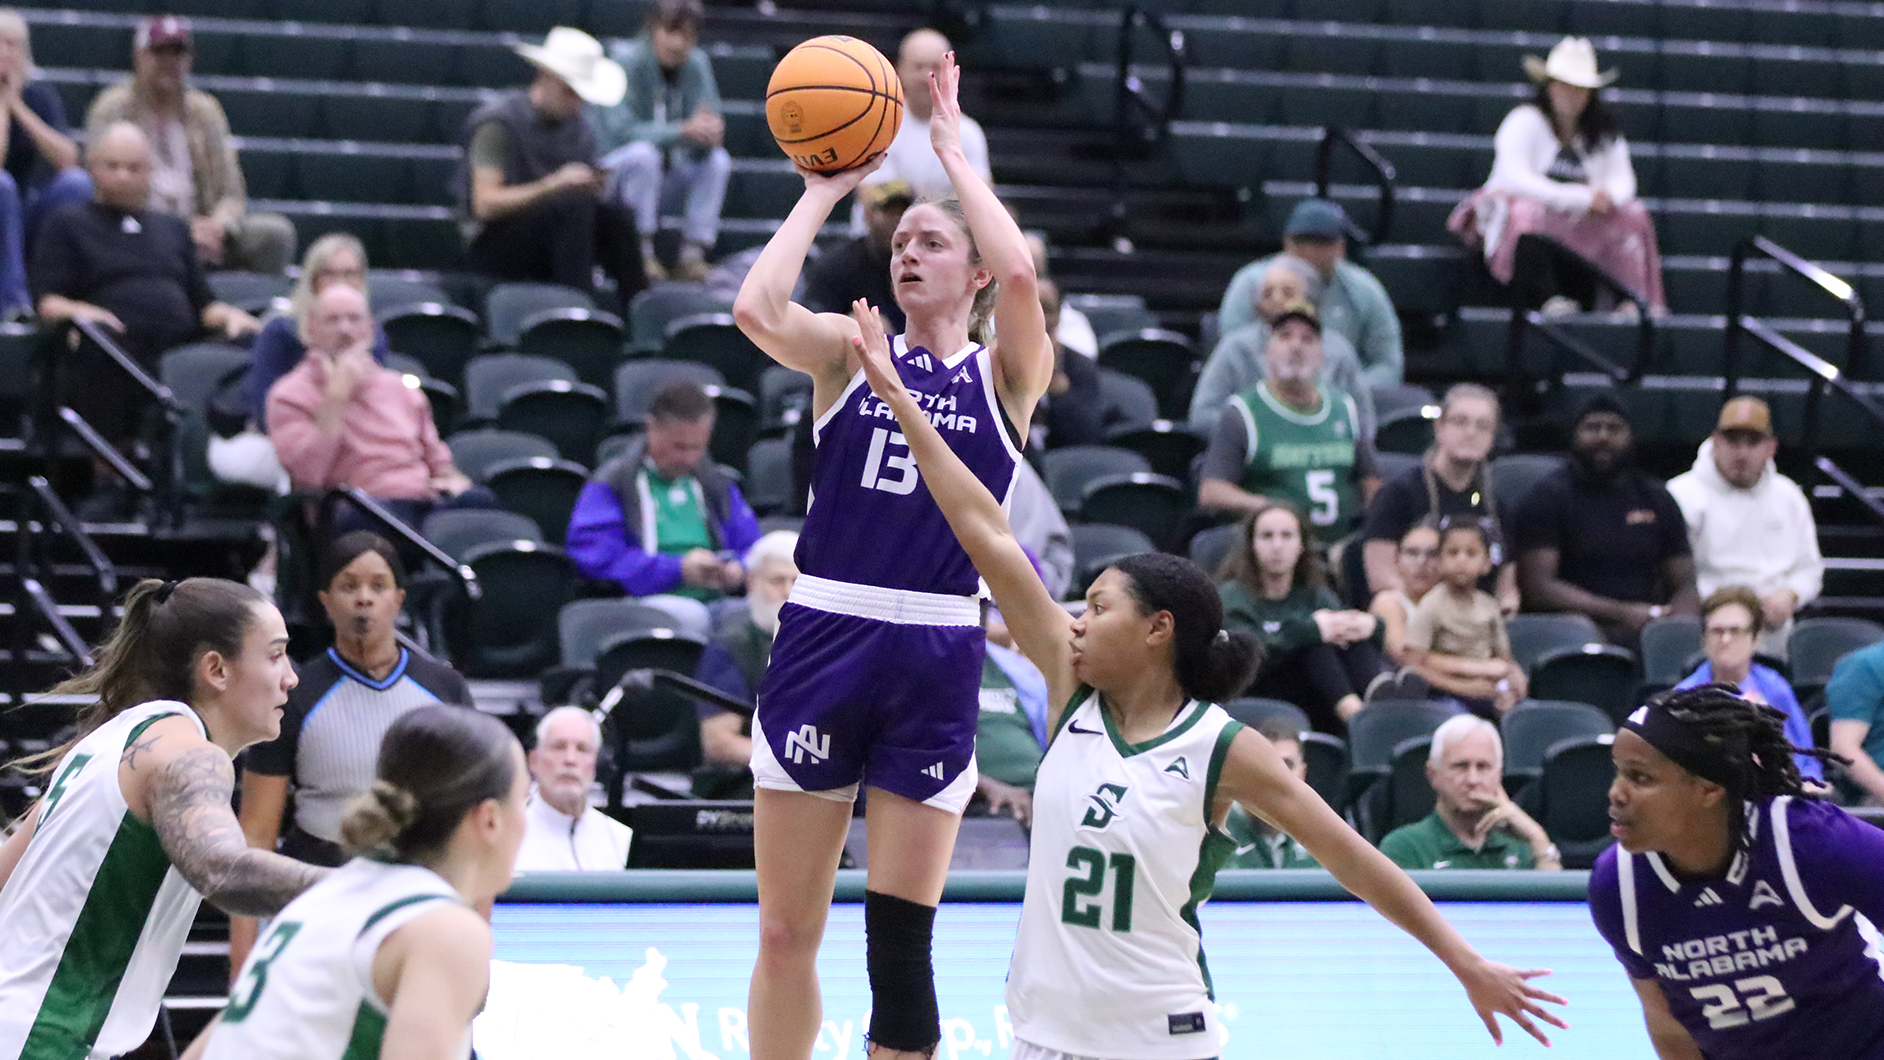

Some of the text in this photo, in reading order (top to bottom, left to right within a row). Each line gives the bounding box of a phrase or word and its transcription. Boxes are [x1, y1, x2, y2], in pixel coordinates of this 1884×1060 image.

[860, 427, 919, 495] 13
[1306, 470, 1338, 526] 5
[1062, 845, 1135, 933] 21
[1654, 937, 1808, 981] ALABAMA
[1661, 925, 1778, 962] NORTH
[221, 921, 304, 1023] 3
[1689, 975, 1796, 1030] 22
